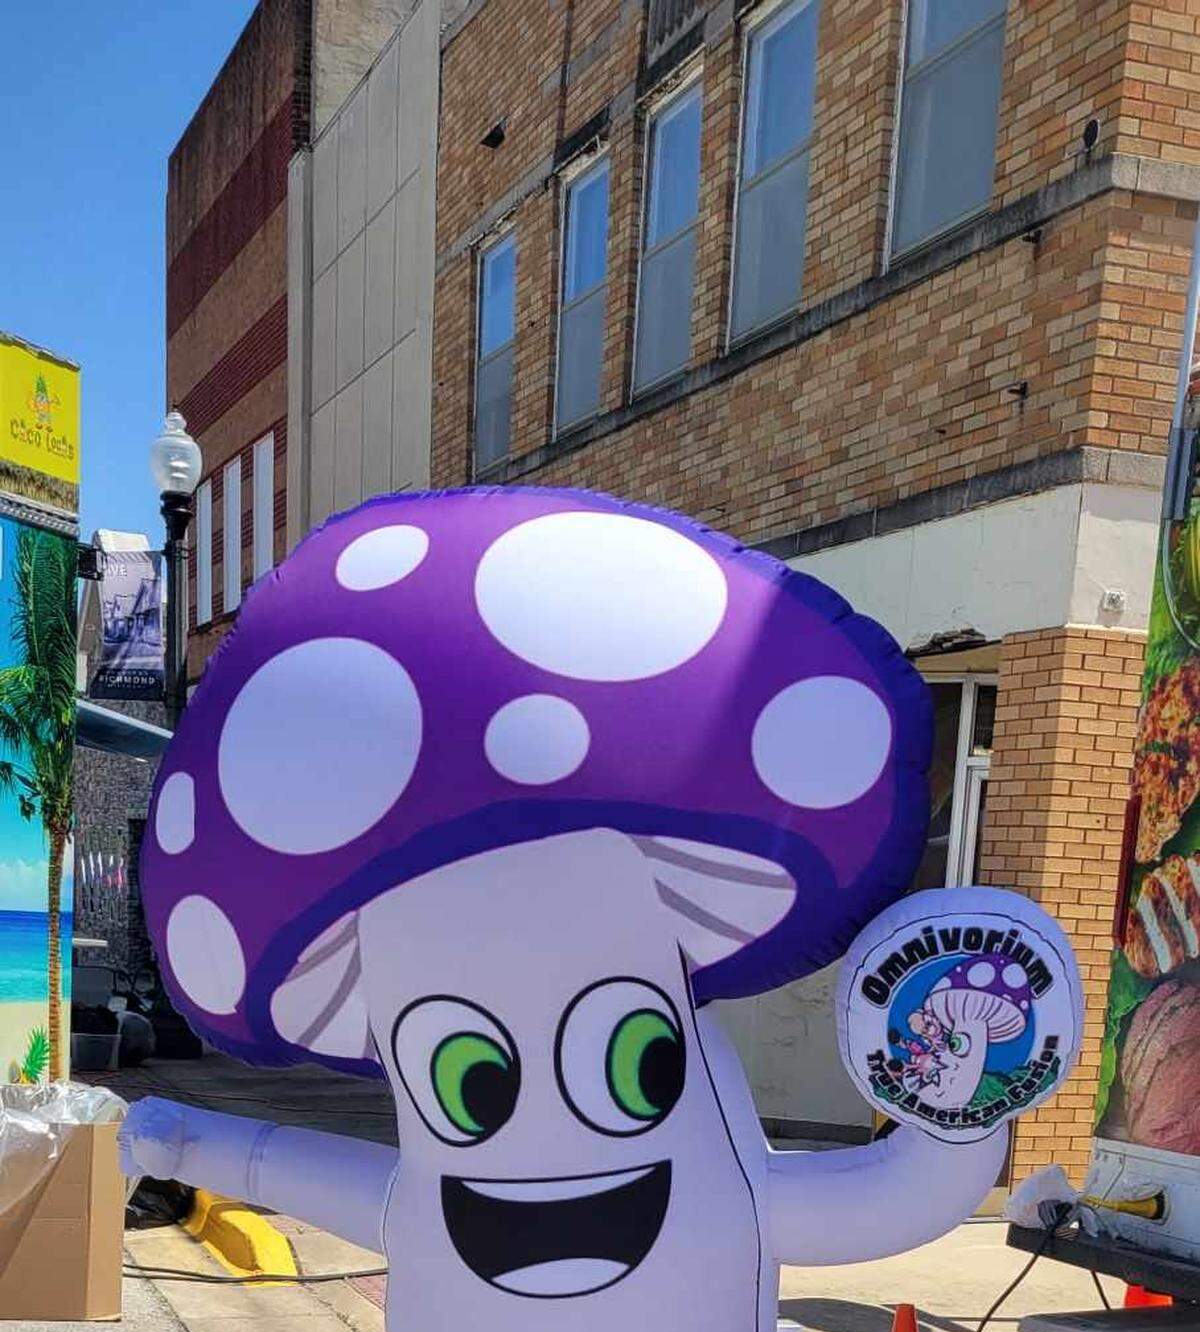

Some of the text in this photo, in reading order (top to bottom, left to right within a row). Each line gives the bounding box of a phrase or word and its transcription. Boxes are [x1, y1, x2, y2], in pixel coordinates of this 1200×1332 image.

[862, 926, 1054, 1007] Omnivorium
[867, 1035, 1061, 1125] True American Fusion
